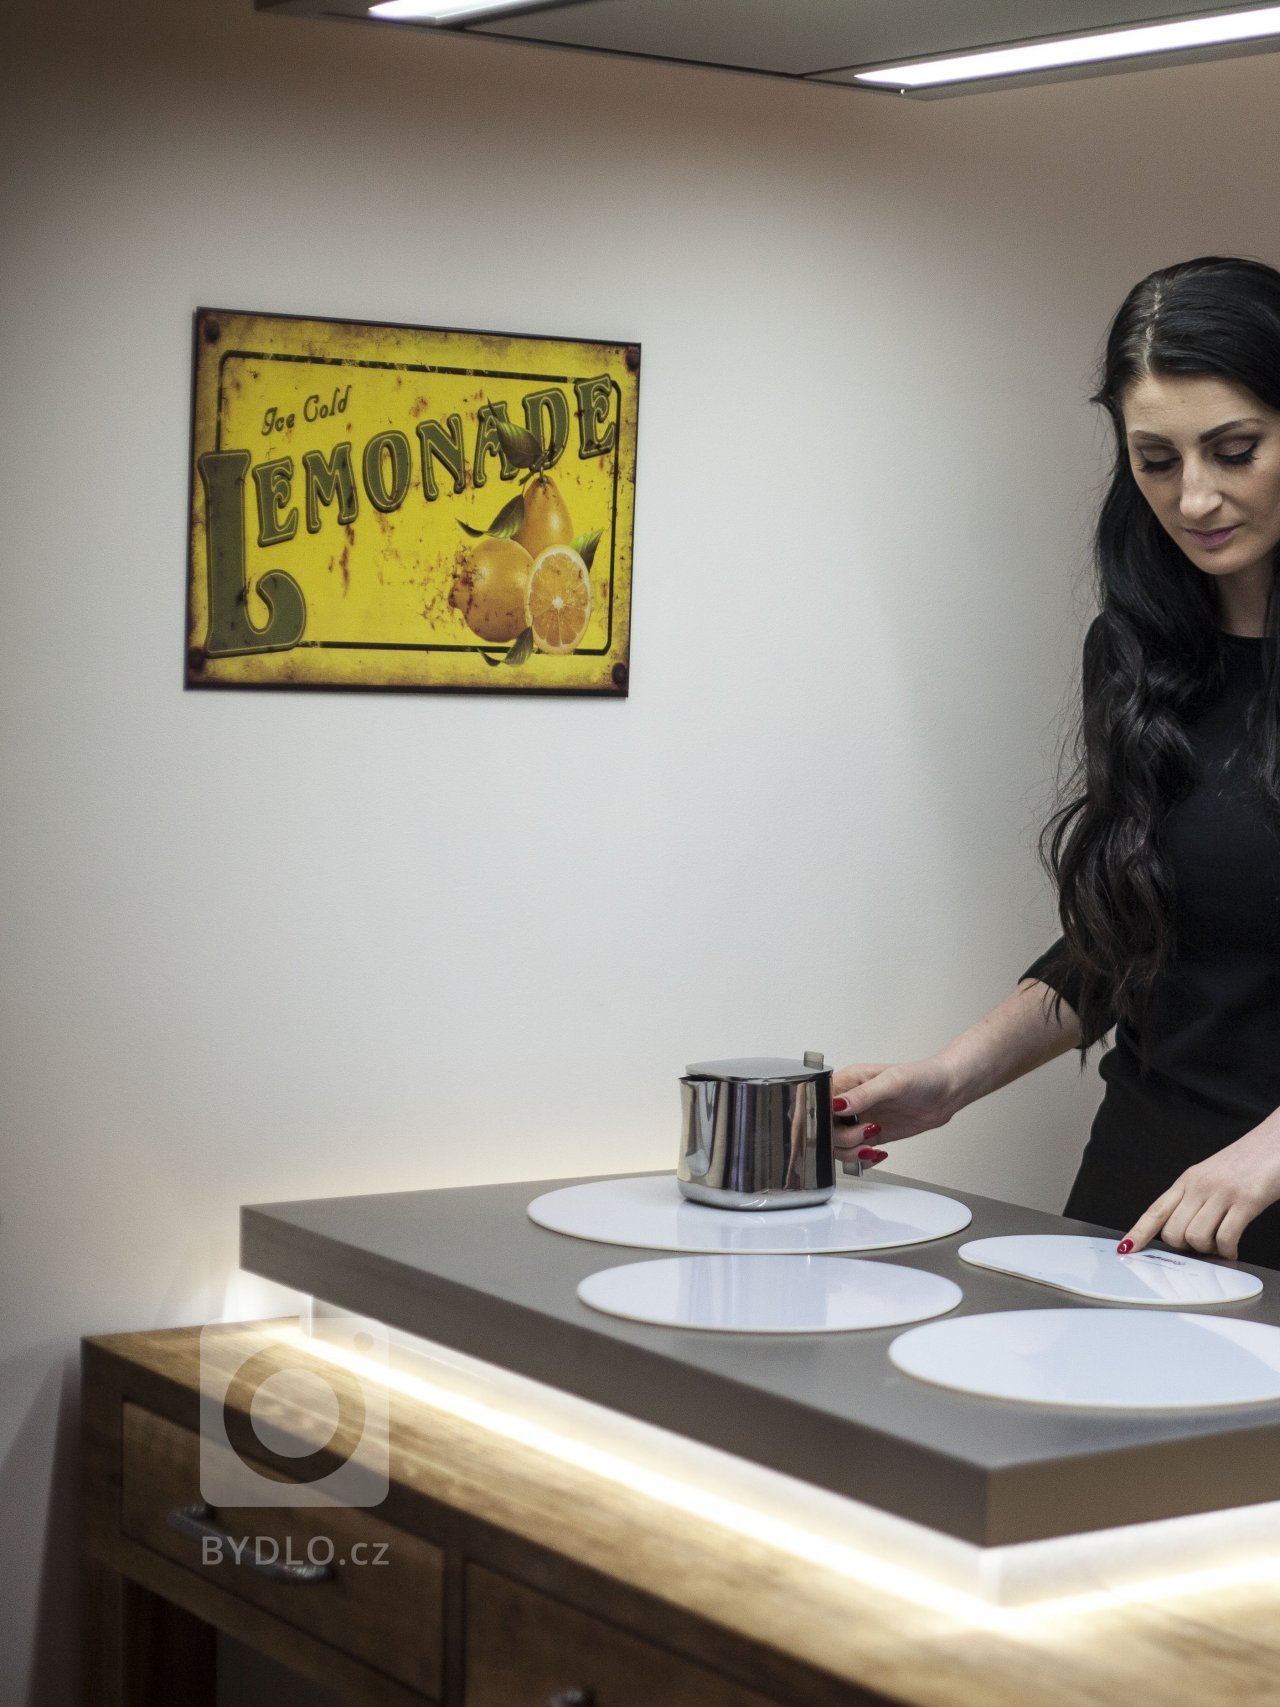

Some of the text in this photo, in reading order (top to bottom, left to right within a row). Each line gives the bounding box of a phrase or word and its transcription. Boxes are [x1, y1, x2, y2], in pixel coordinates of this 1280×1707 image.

[261, 384, 353, 436] Ice Cold
[198, 373, 617, 658] LEMONADE
